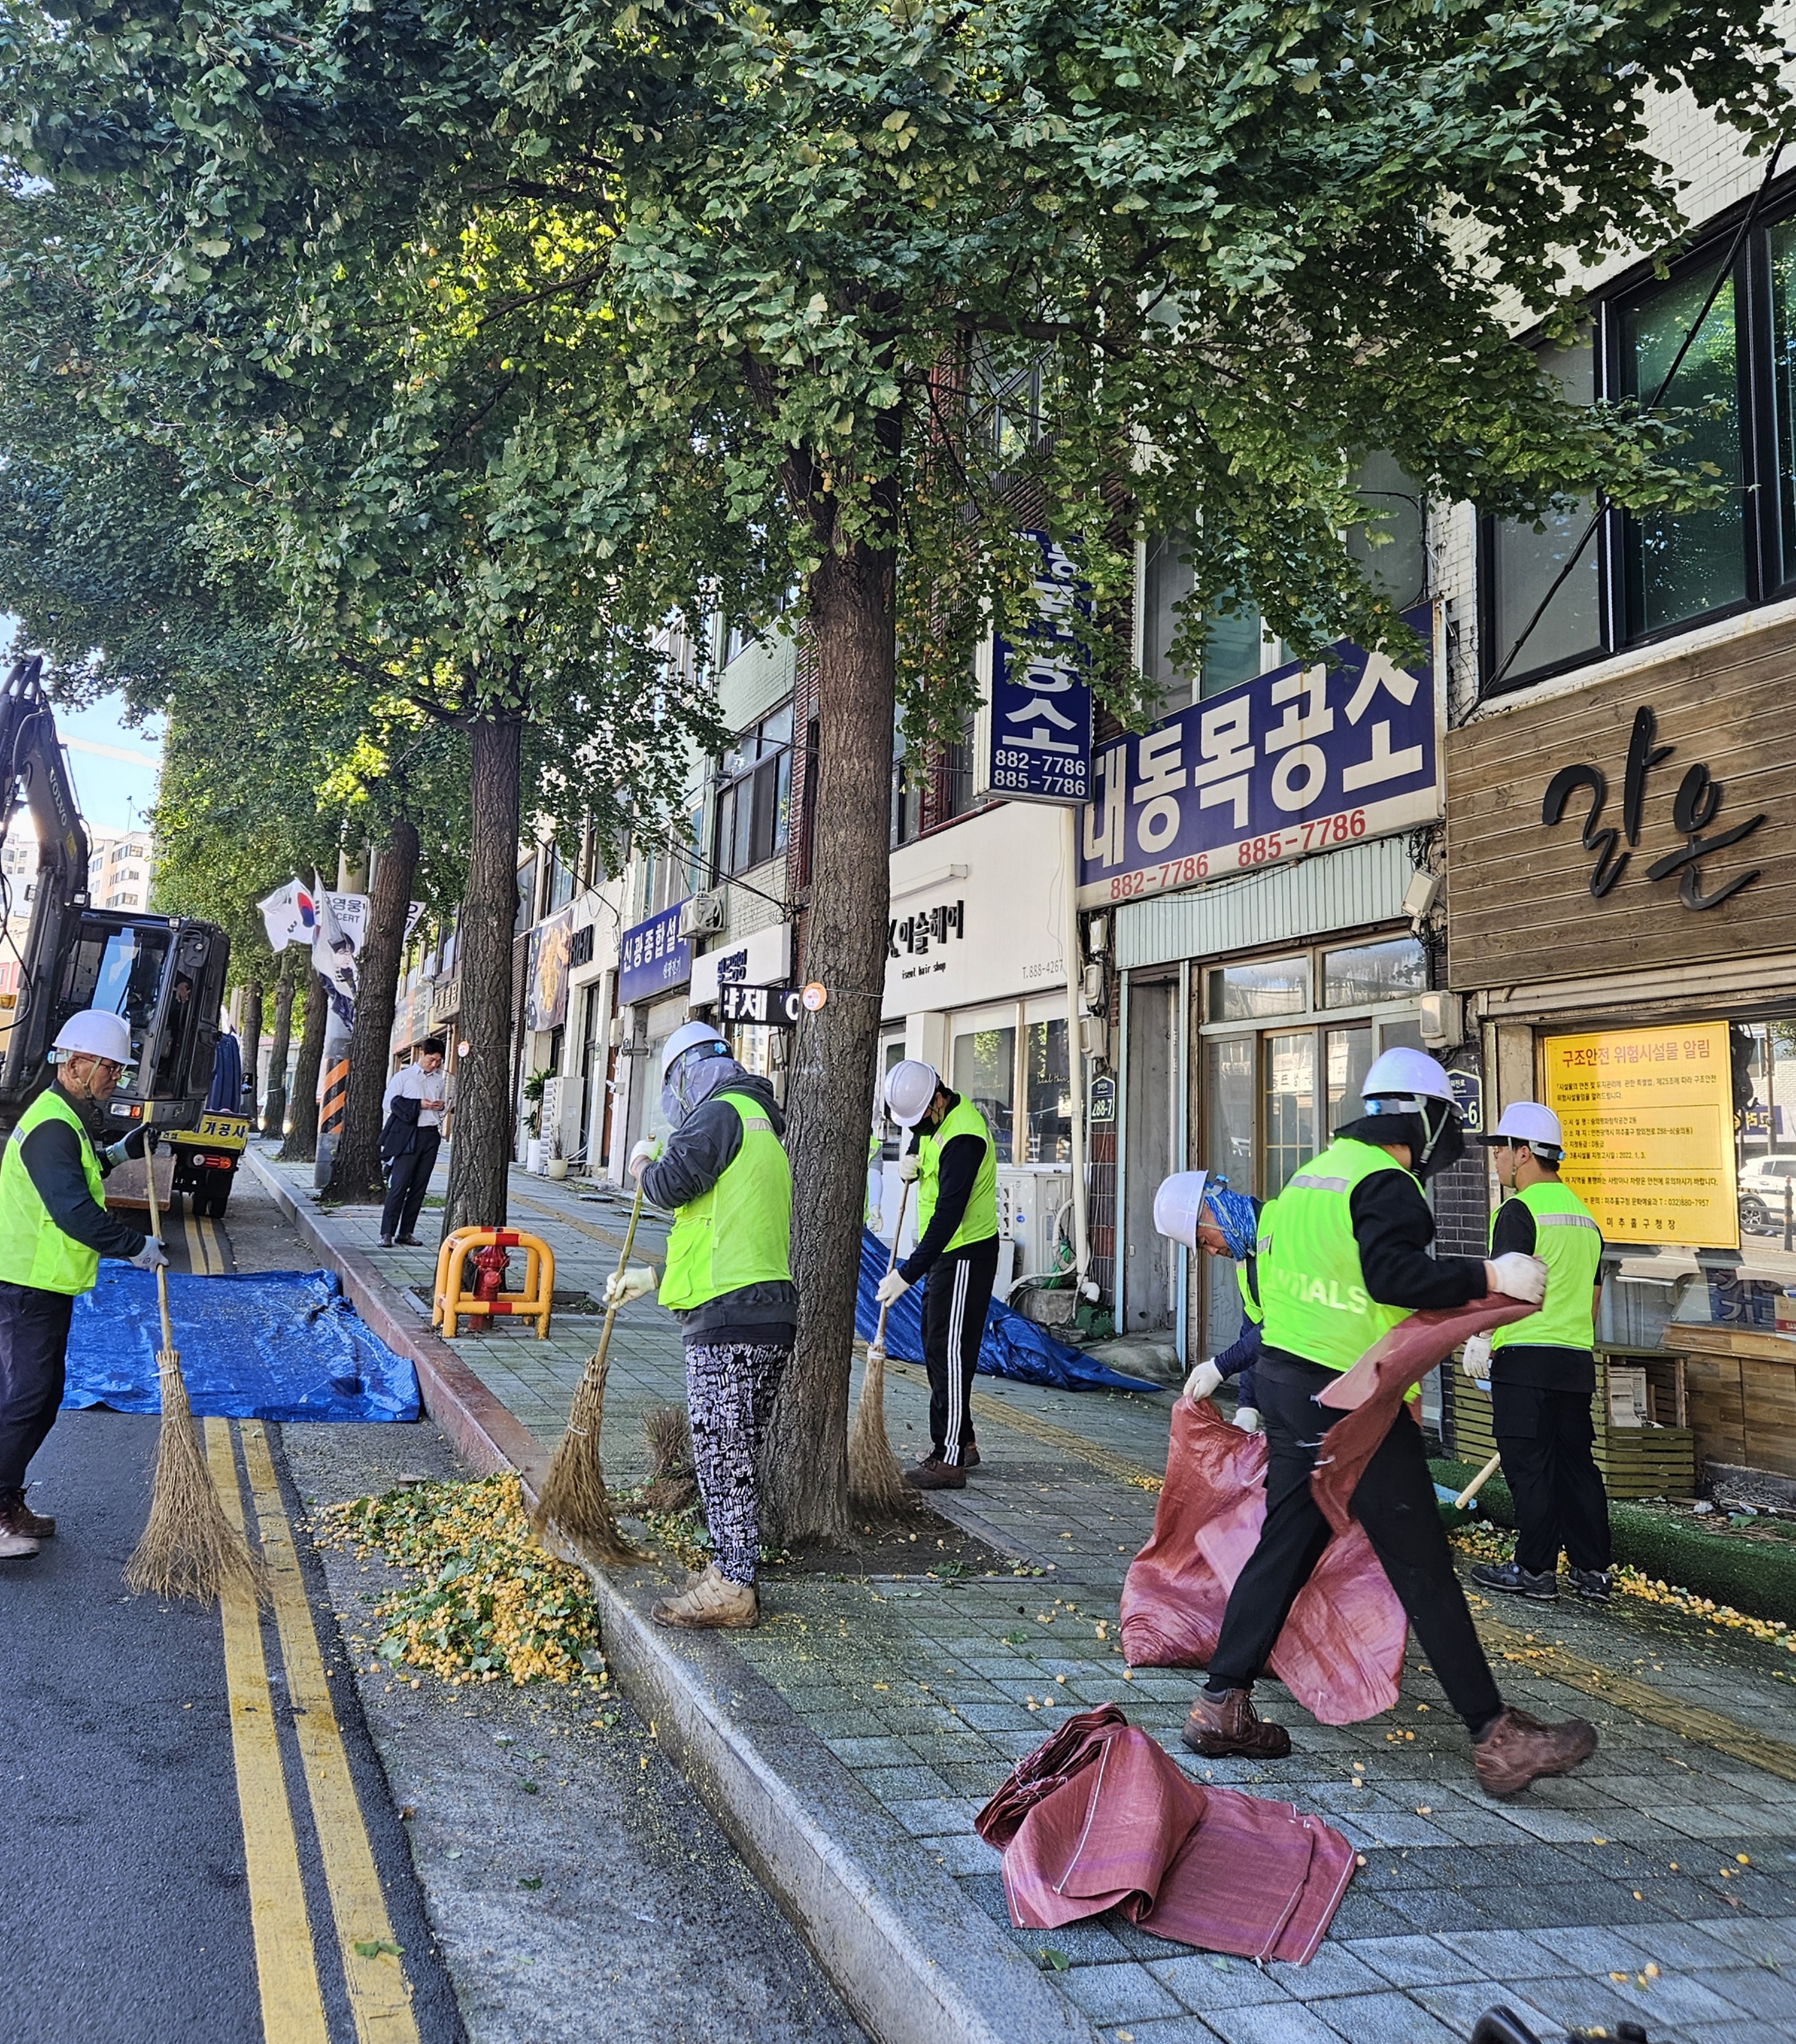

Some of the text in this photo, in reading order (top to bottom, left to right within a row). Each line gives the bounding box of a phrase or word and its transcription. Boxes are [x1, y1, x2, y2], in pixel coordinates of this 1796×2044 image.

[995, 750, 1086, 777] 882-7786
[1083, 638, 1423, 868] 대동목공소
[49, 767, 68, 827] VOLVO
[994, 770, 1086, 796] 885-7786
[1110, 809, 1367, 900] 882-7786 885-7786
[336, 912, 360, 924] CERT
[899, 900, 964, 956] 이슬헤어
[623, 915, 687, 973] 신광종합설
[918, 964, 930, 977] hair
[933, 961, 946, 974] shop
[1563, 1039, 1710, 1068] 구조안전 위험시설물 알림
